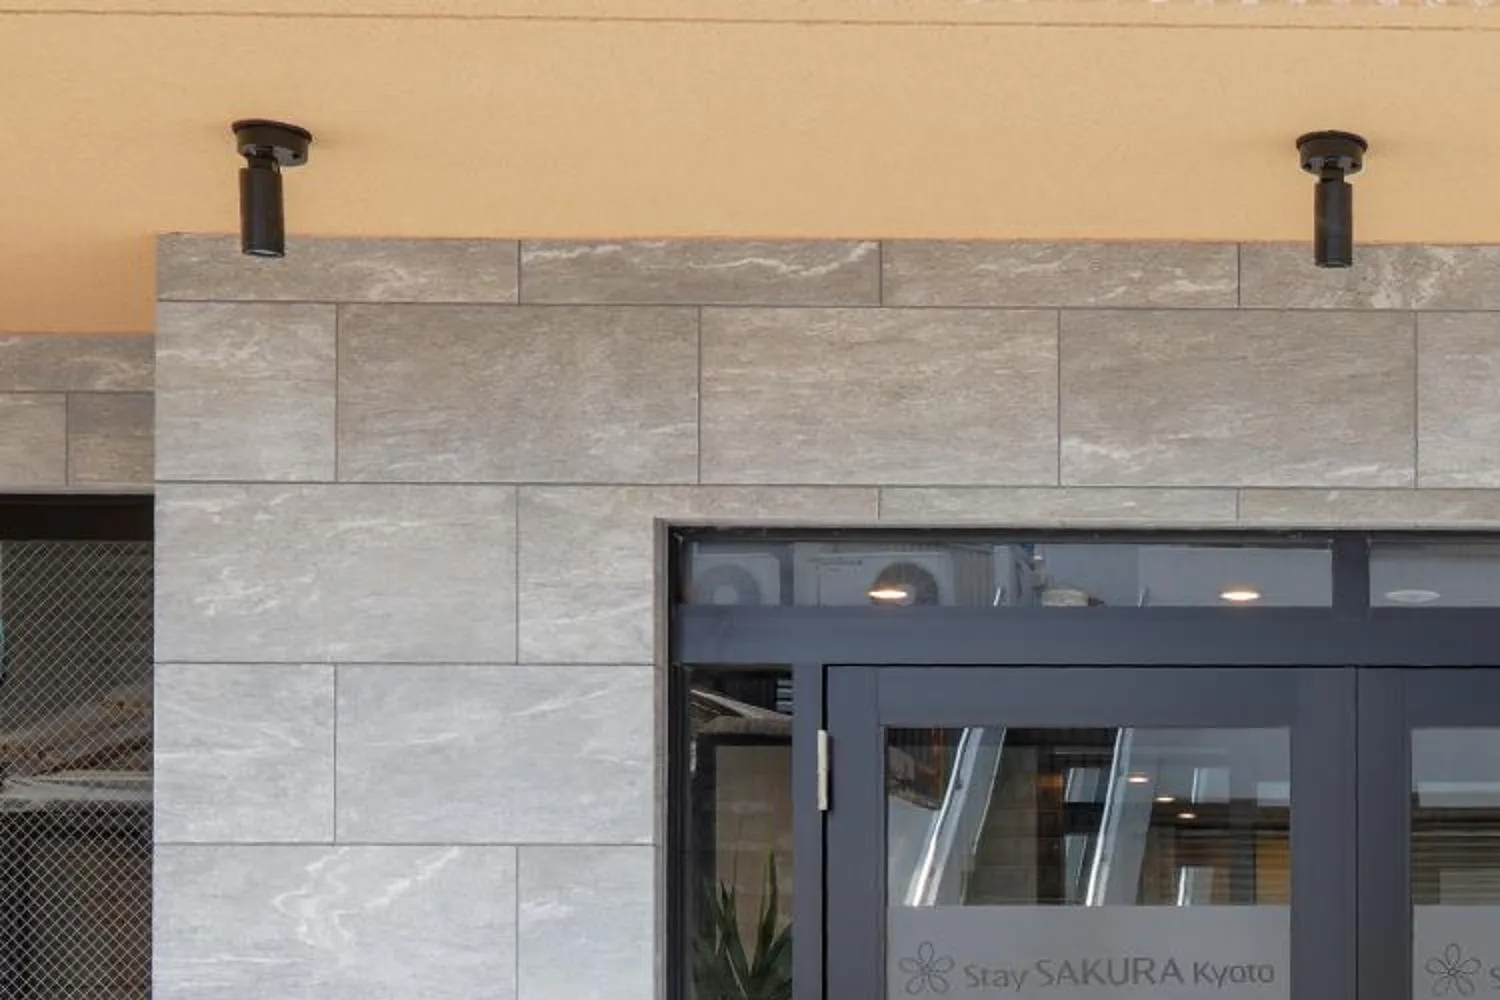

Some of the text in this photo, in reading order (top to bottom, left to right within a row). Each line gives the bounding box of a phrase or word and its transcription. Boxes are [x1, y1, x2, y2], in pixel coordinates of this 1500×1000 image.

[963, 957, 1275, 992] Stay SAKURA Kyoto
